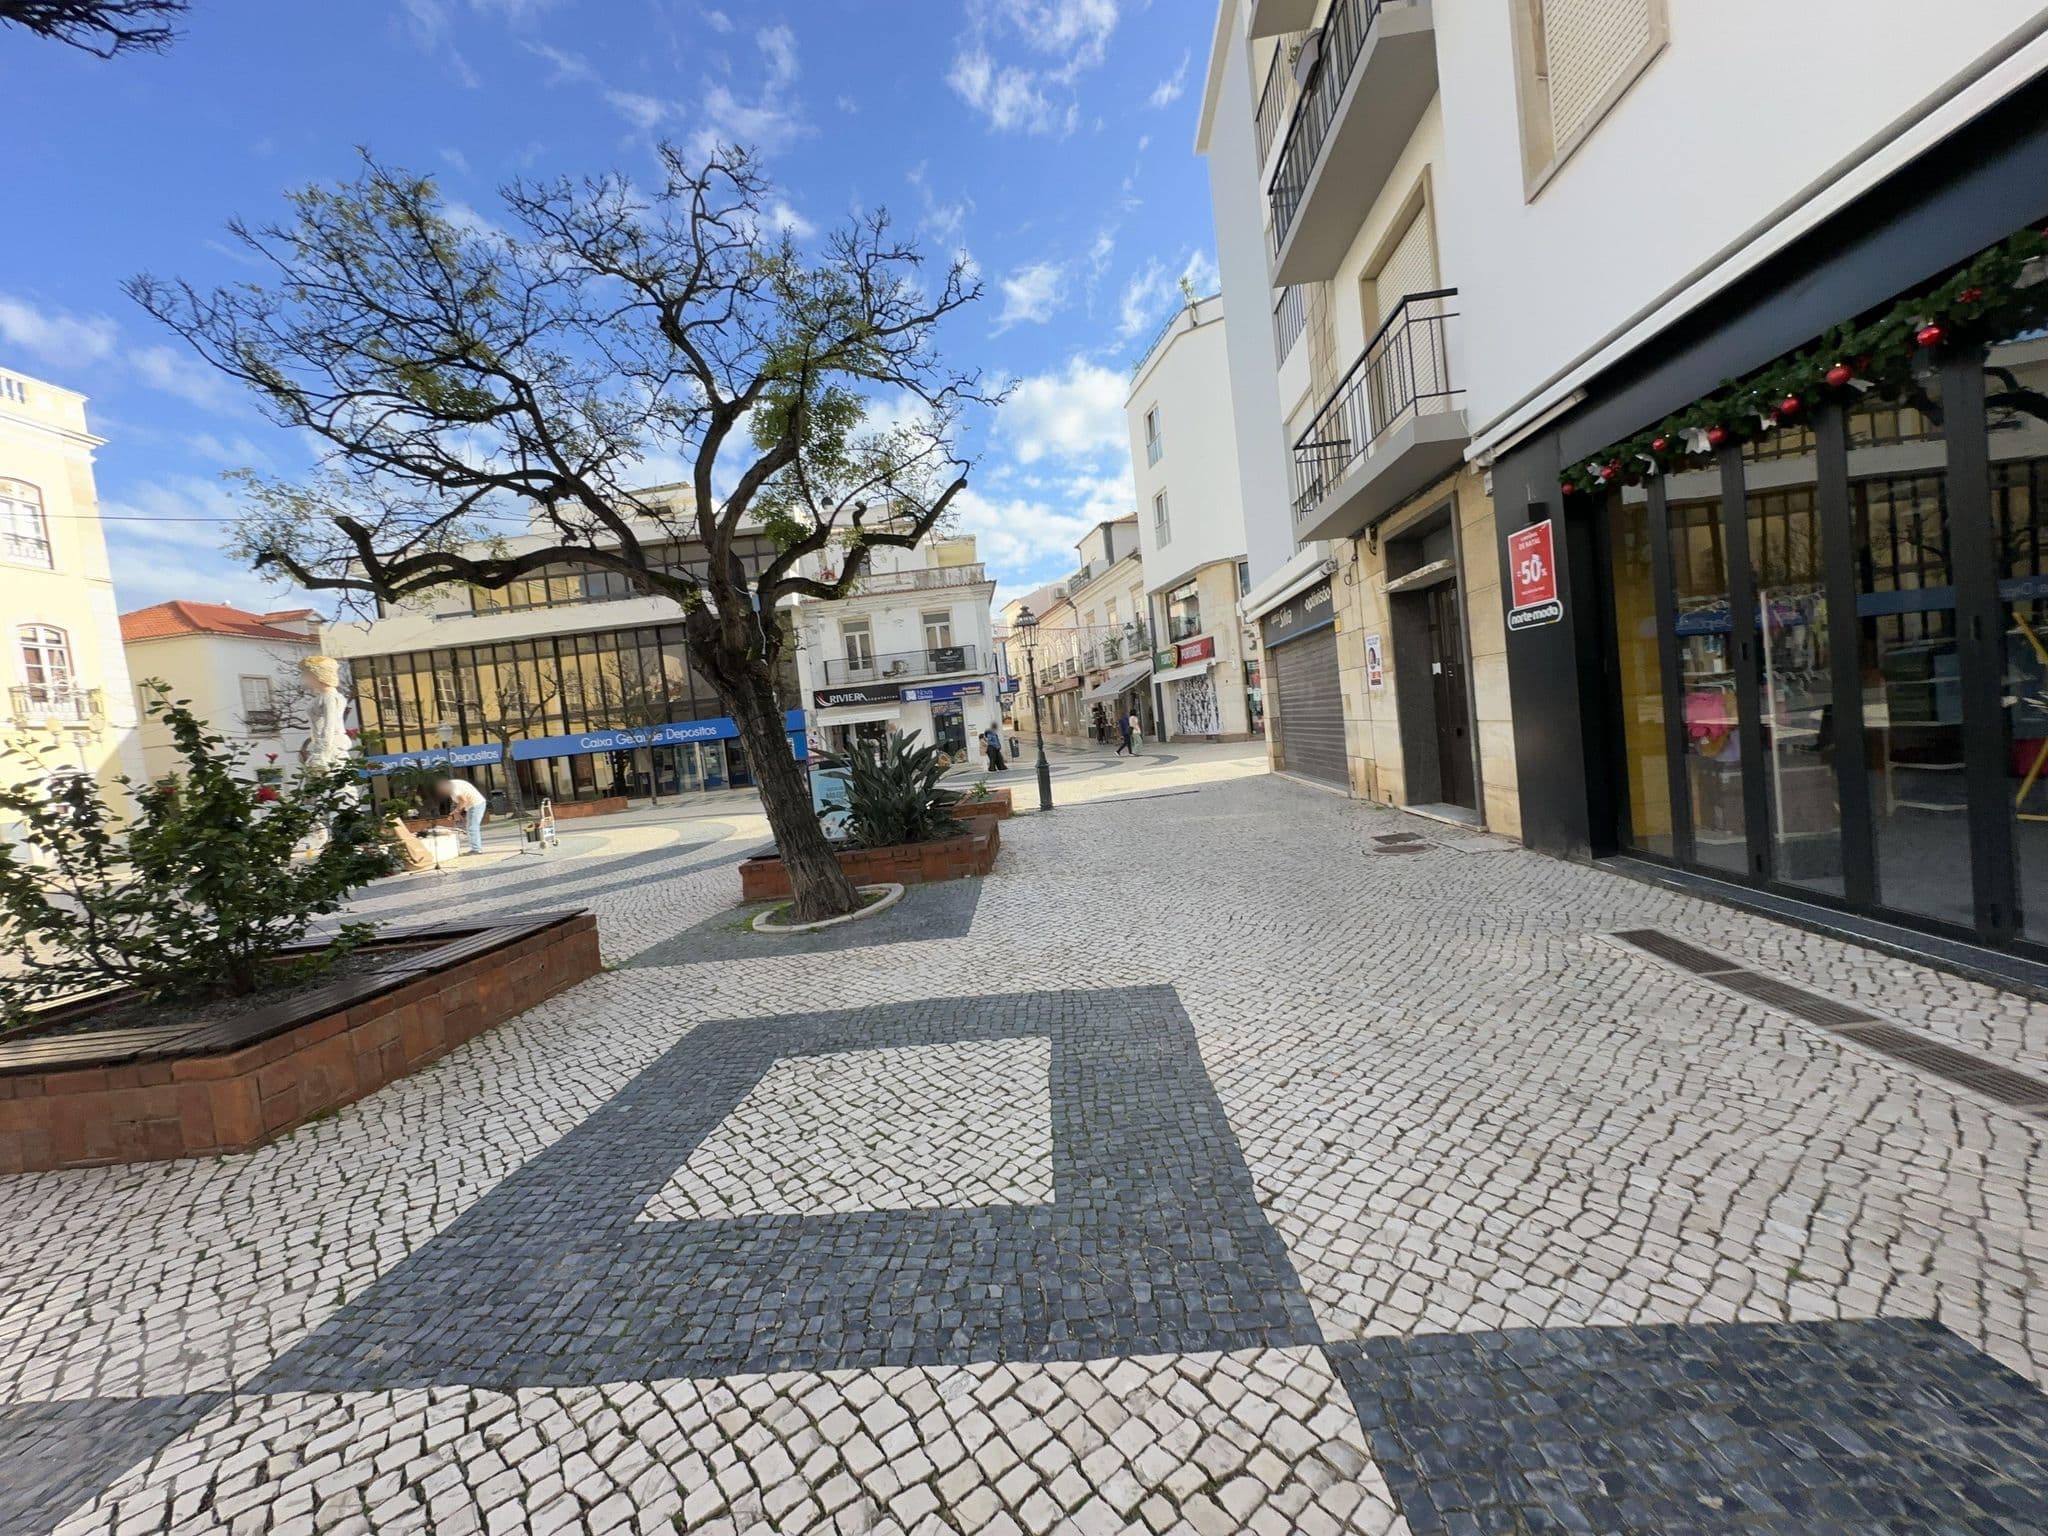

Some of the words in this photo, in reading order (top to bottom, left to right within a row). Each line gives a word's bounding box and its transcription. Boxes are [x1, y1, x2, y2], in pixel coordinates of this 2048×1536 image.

[829, 692, 868, 704] RIVIERA
[580, 737, 613, 749] Caixa
[666, 726, 717, 740] Depositos
[449, 749, 500, 763] Depositos
